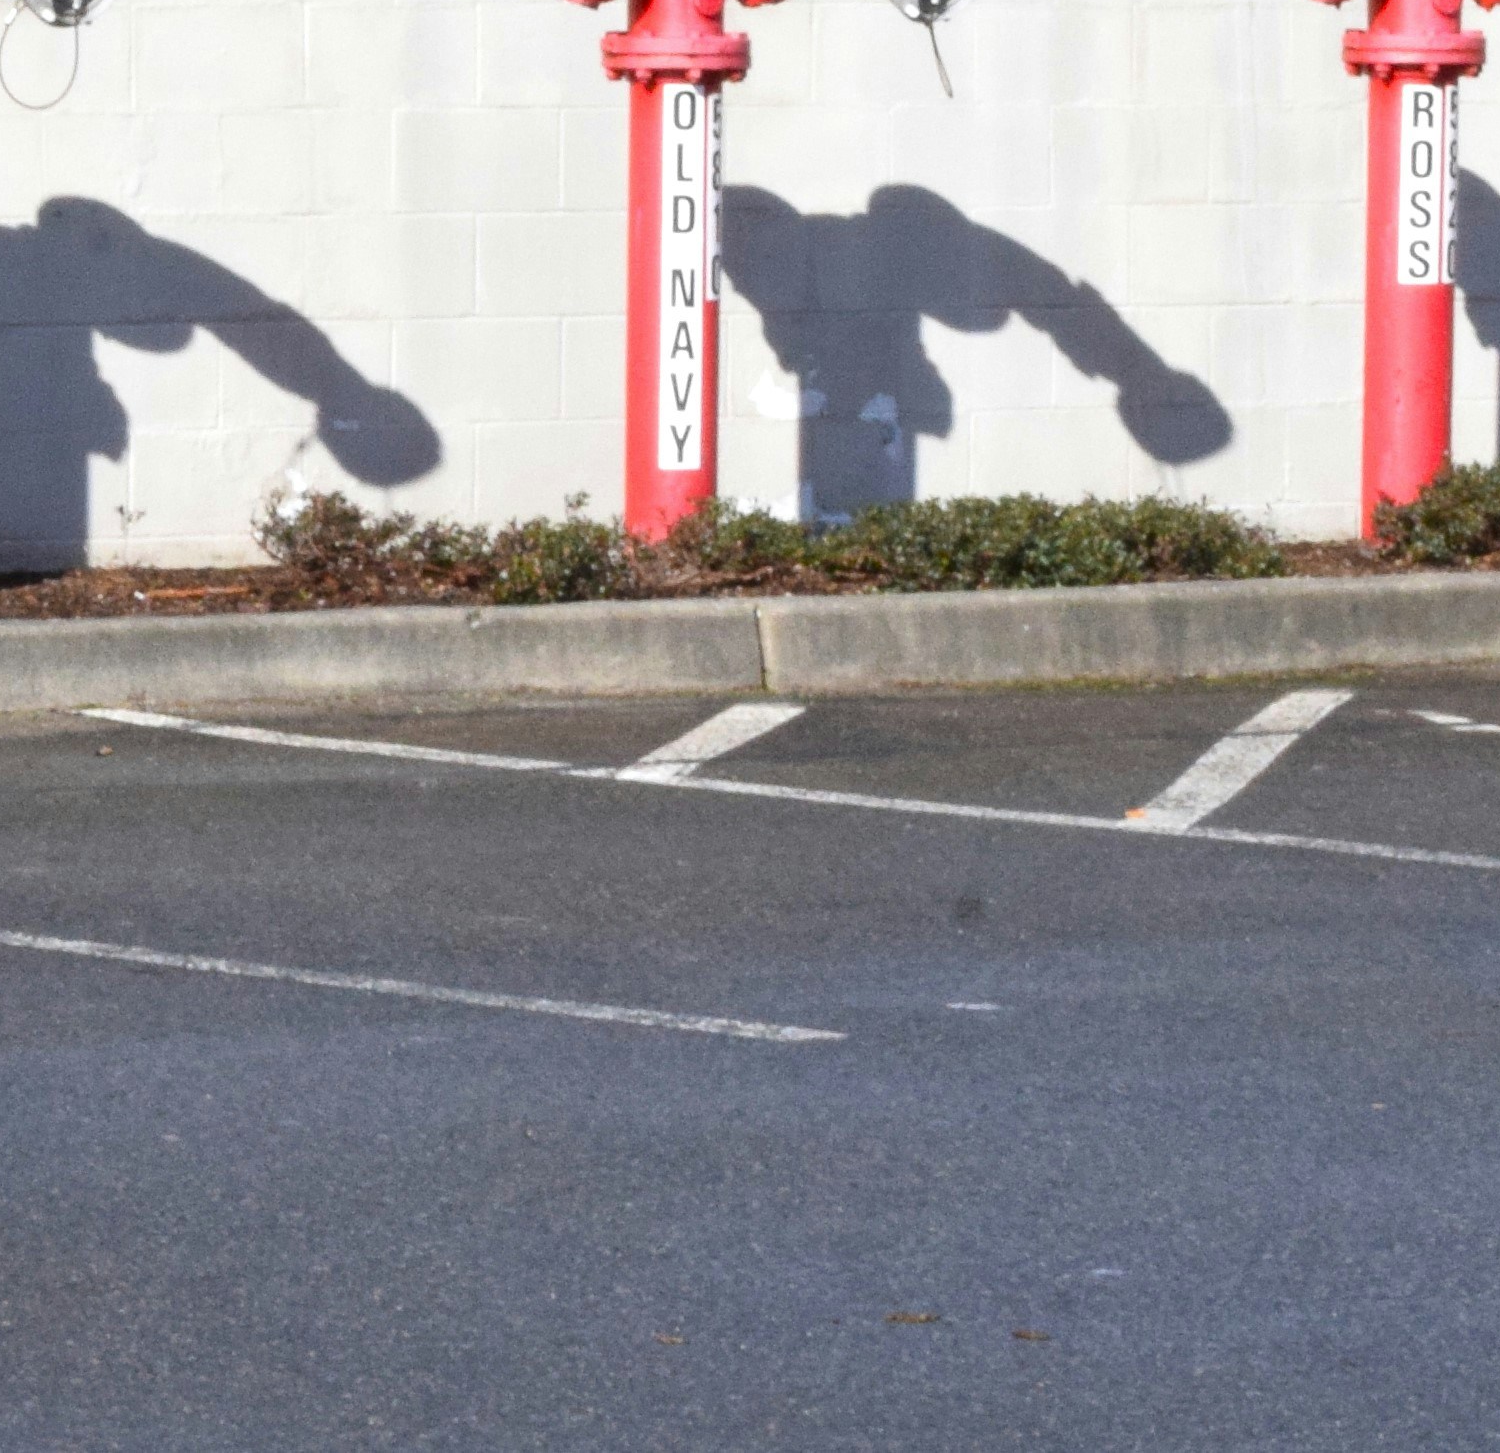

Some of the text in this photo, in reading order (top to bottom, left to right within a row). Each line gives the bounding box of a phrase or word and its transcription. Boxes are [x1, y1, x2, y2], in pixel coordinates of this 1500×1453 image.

[670, 90, 697, 463] OLD NAVY
[1408, 90, 1434, 278] ROSS
